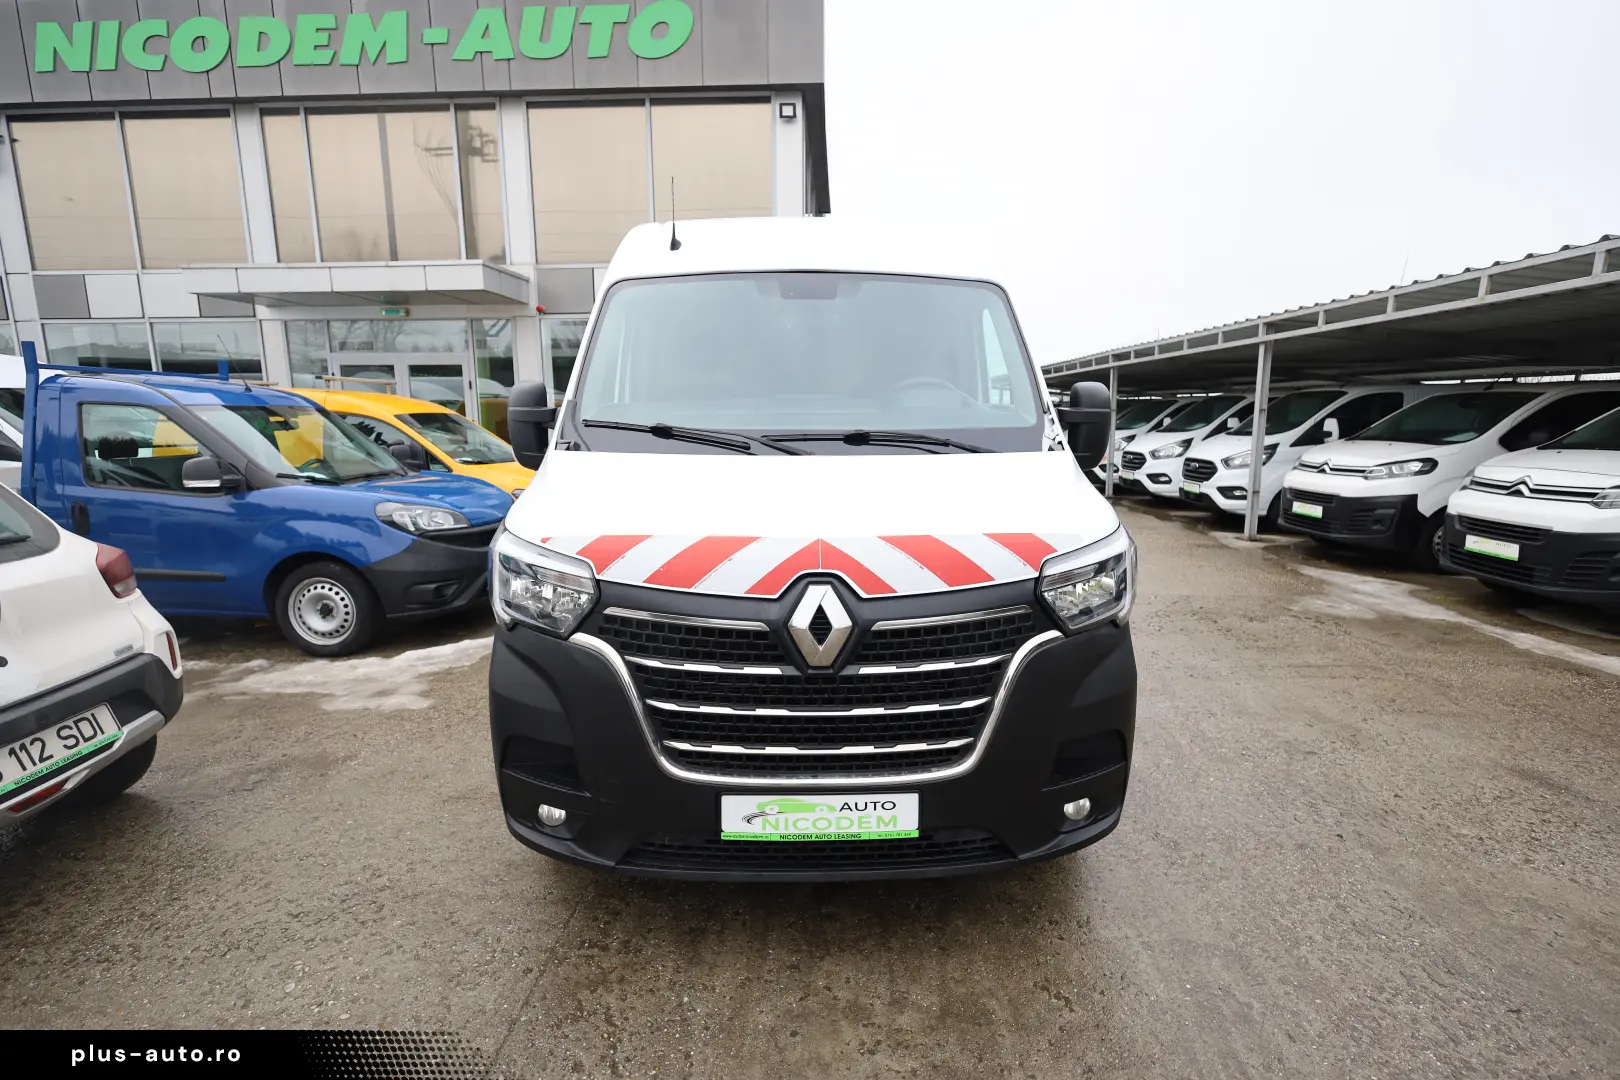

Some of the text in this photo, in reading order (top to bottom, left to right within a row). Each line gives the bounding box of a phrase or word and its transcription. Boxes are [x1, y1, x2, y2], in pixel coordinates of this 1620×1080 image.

[8, 712, 105, 772] 112 SDI
[14, 768, 45, 787] NICODEM
[45, 761, 61, 772] AUTO
[60, 750, 83, 764] LEASING
[839, 801, 897, 812] AUTO
[761, 814, 898, 832] NICODEM
[779, 833, 814, 841] NICODEM
[833, 832, 862, 840] LEASING
